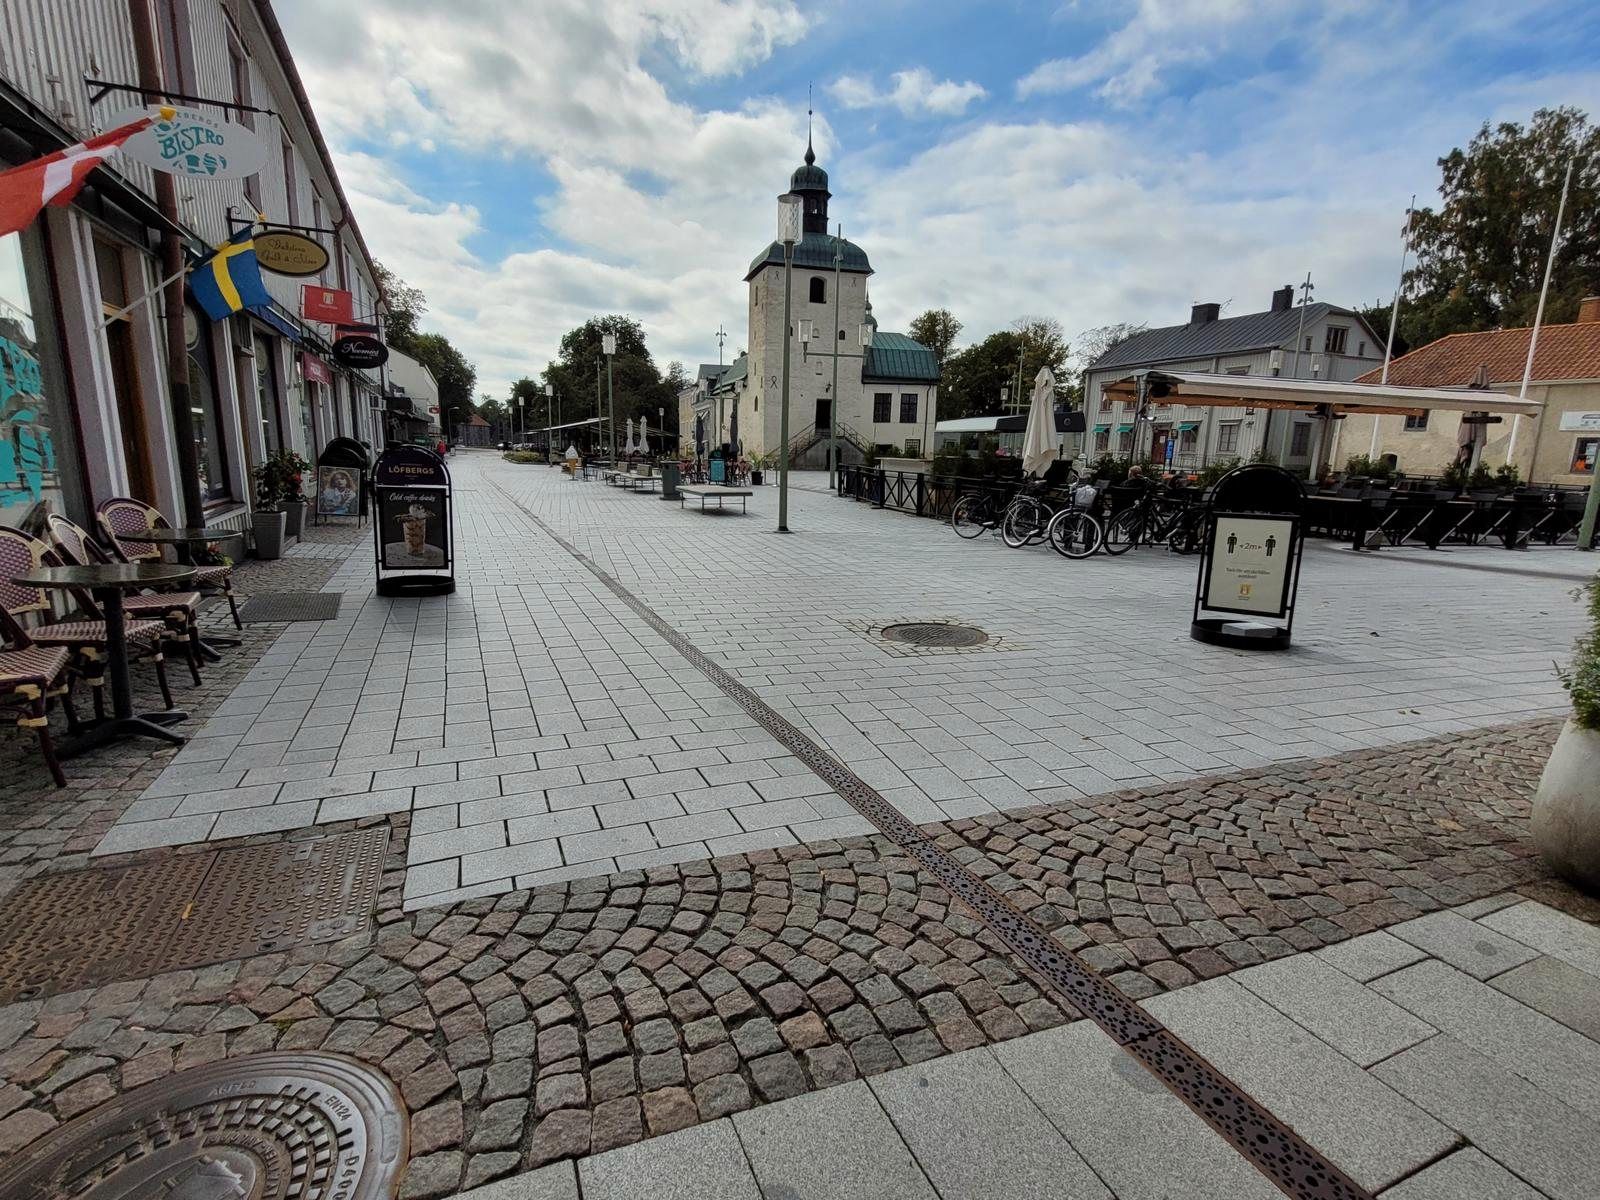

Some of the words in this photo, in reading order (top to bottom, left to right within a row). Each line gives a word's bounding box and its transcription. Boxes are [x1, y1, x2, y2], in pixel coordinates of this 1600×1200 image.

[158, 126, 224, 159] BISTRO
[388, 464, 434, 475] LÖFBERGS
[389, 492, 403, 501] Cold
[324, 1094, 353, 1122] EN124
